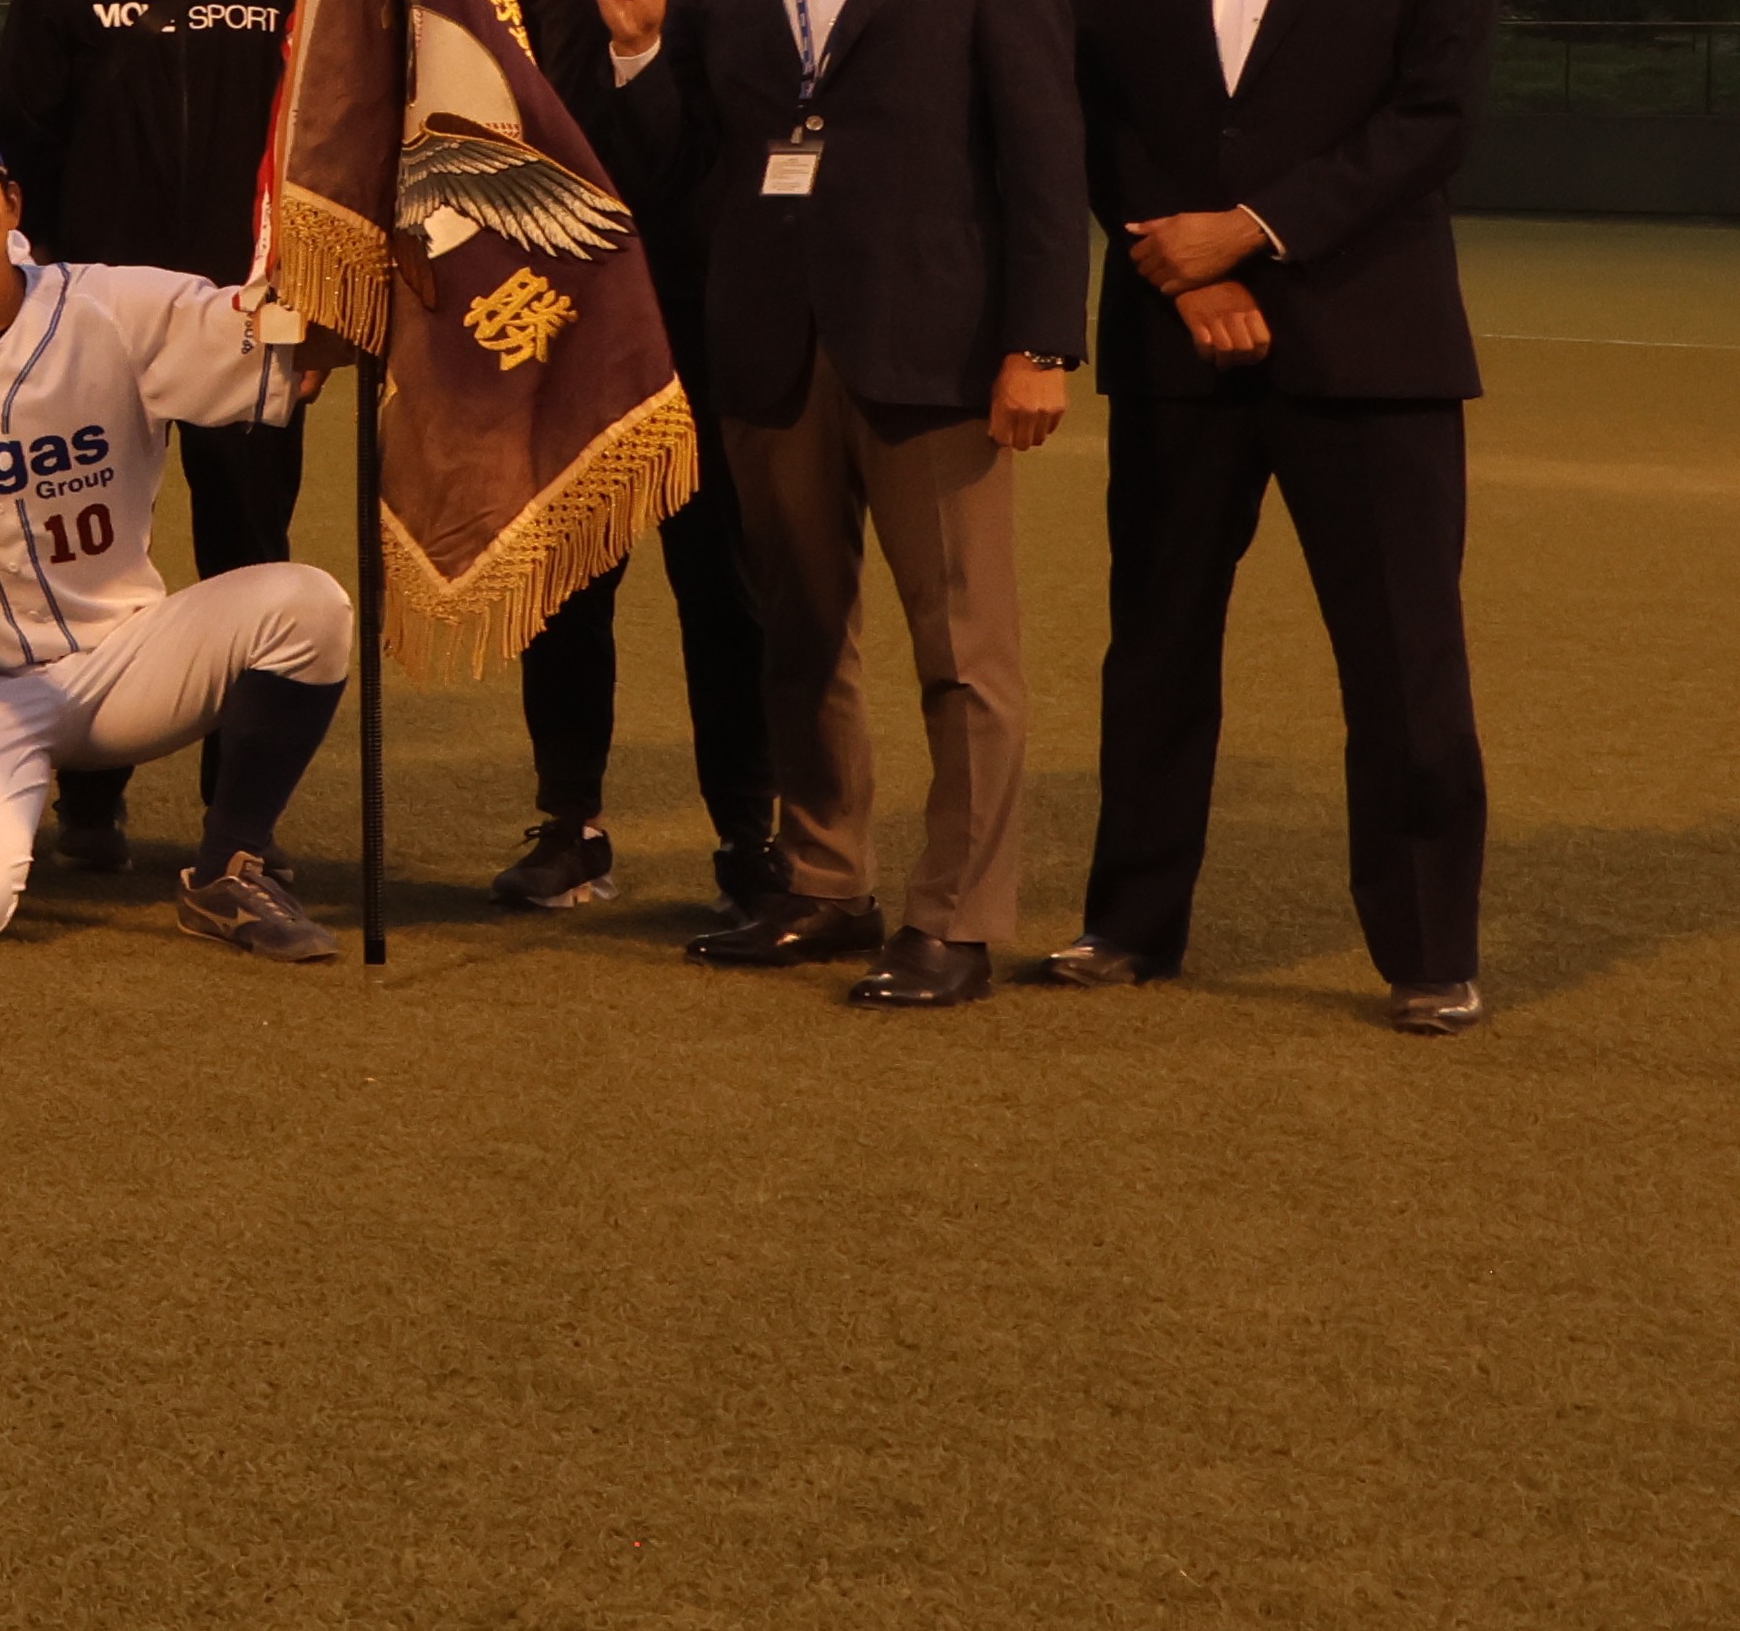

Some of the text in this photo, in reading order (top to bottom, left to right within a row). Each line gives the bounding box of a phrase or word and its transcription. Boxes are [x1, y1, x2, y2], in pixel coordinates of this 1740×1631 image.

[189, 4, 280, 33] SPORT
[461, 265, 579, 372] 勝
[36, 466, 114, 499] Group
[44, 503, 114, 564] 10
